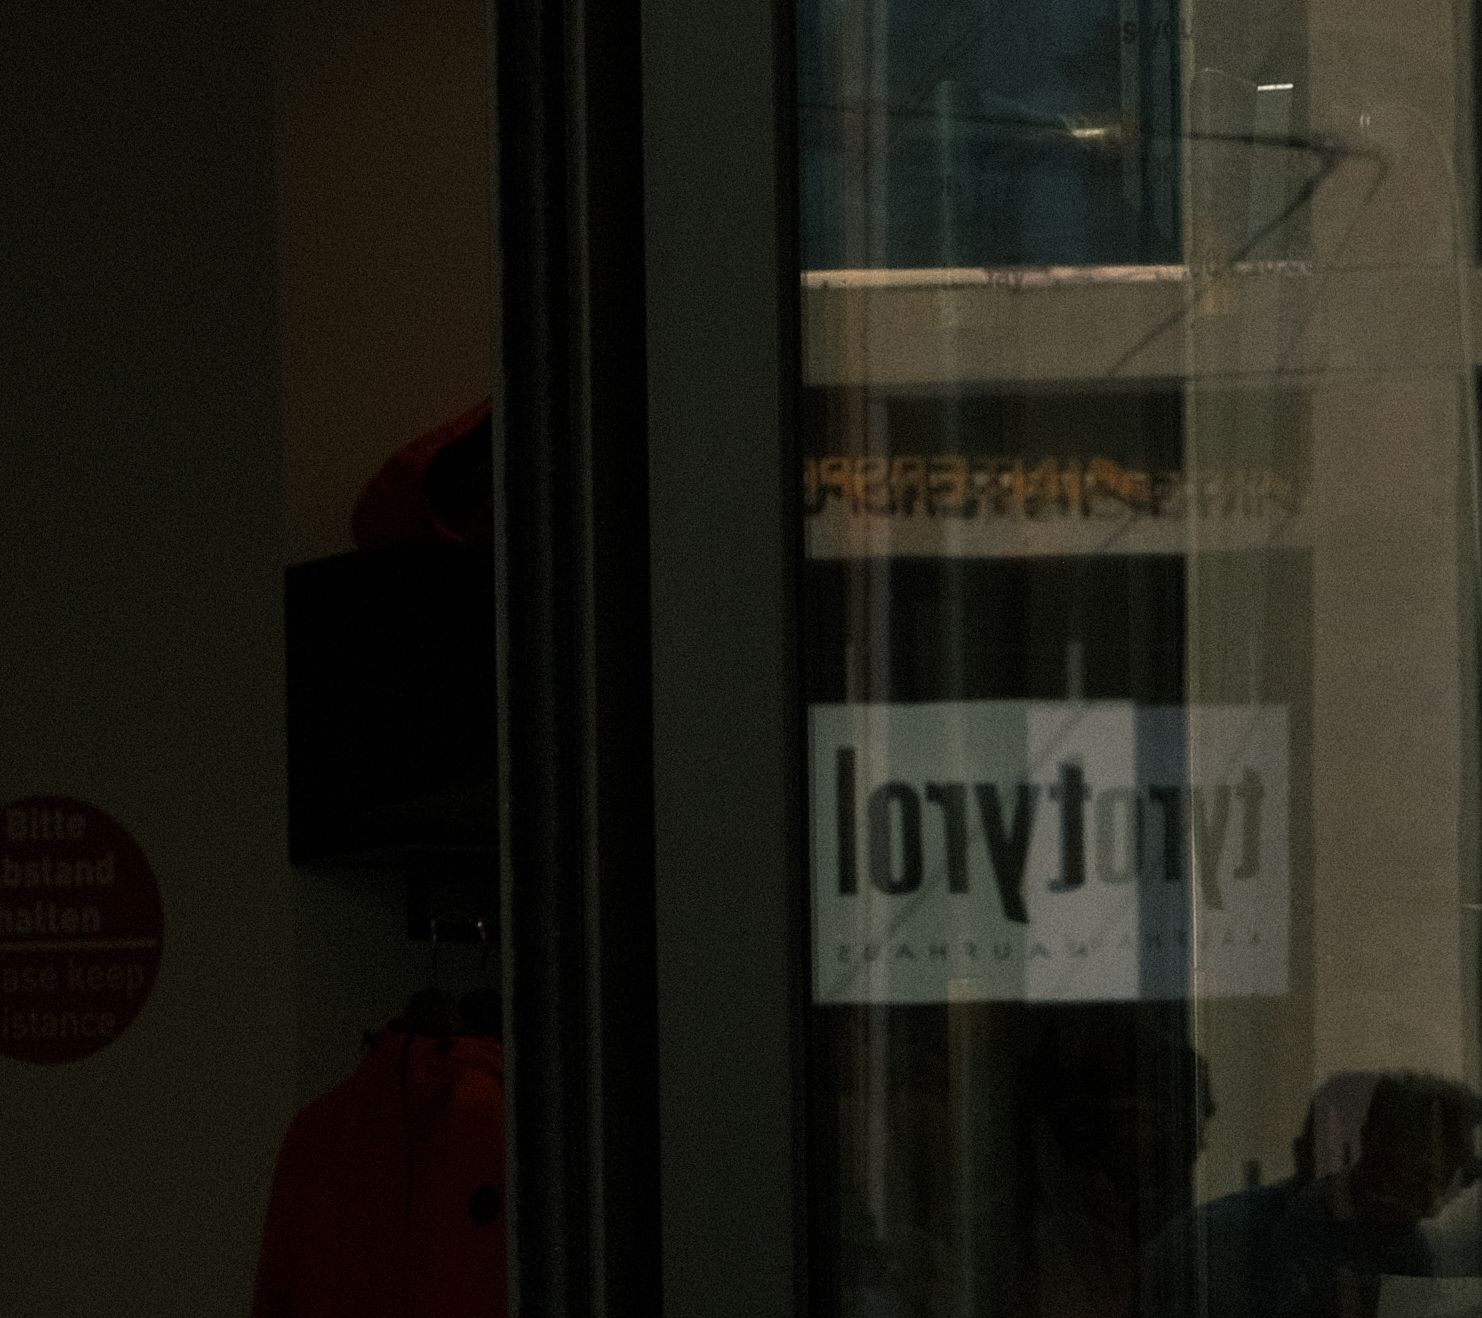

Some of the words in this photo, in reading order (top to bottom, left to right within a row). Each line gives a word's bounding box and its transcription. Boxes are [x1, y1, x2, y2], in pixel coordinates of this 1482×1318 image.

[6, 808, 87, 841] Bitte
[2, 852, 116, 888] bstand
[66, 957, 145, 1001] keep
[2, 1007, 117, 1040] istance
